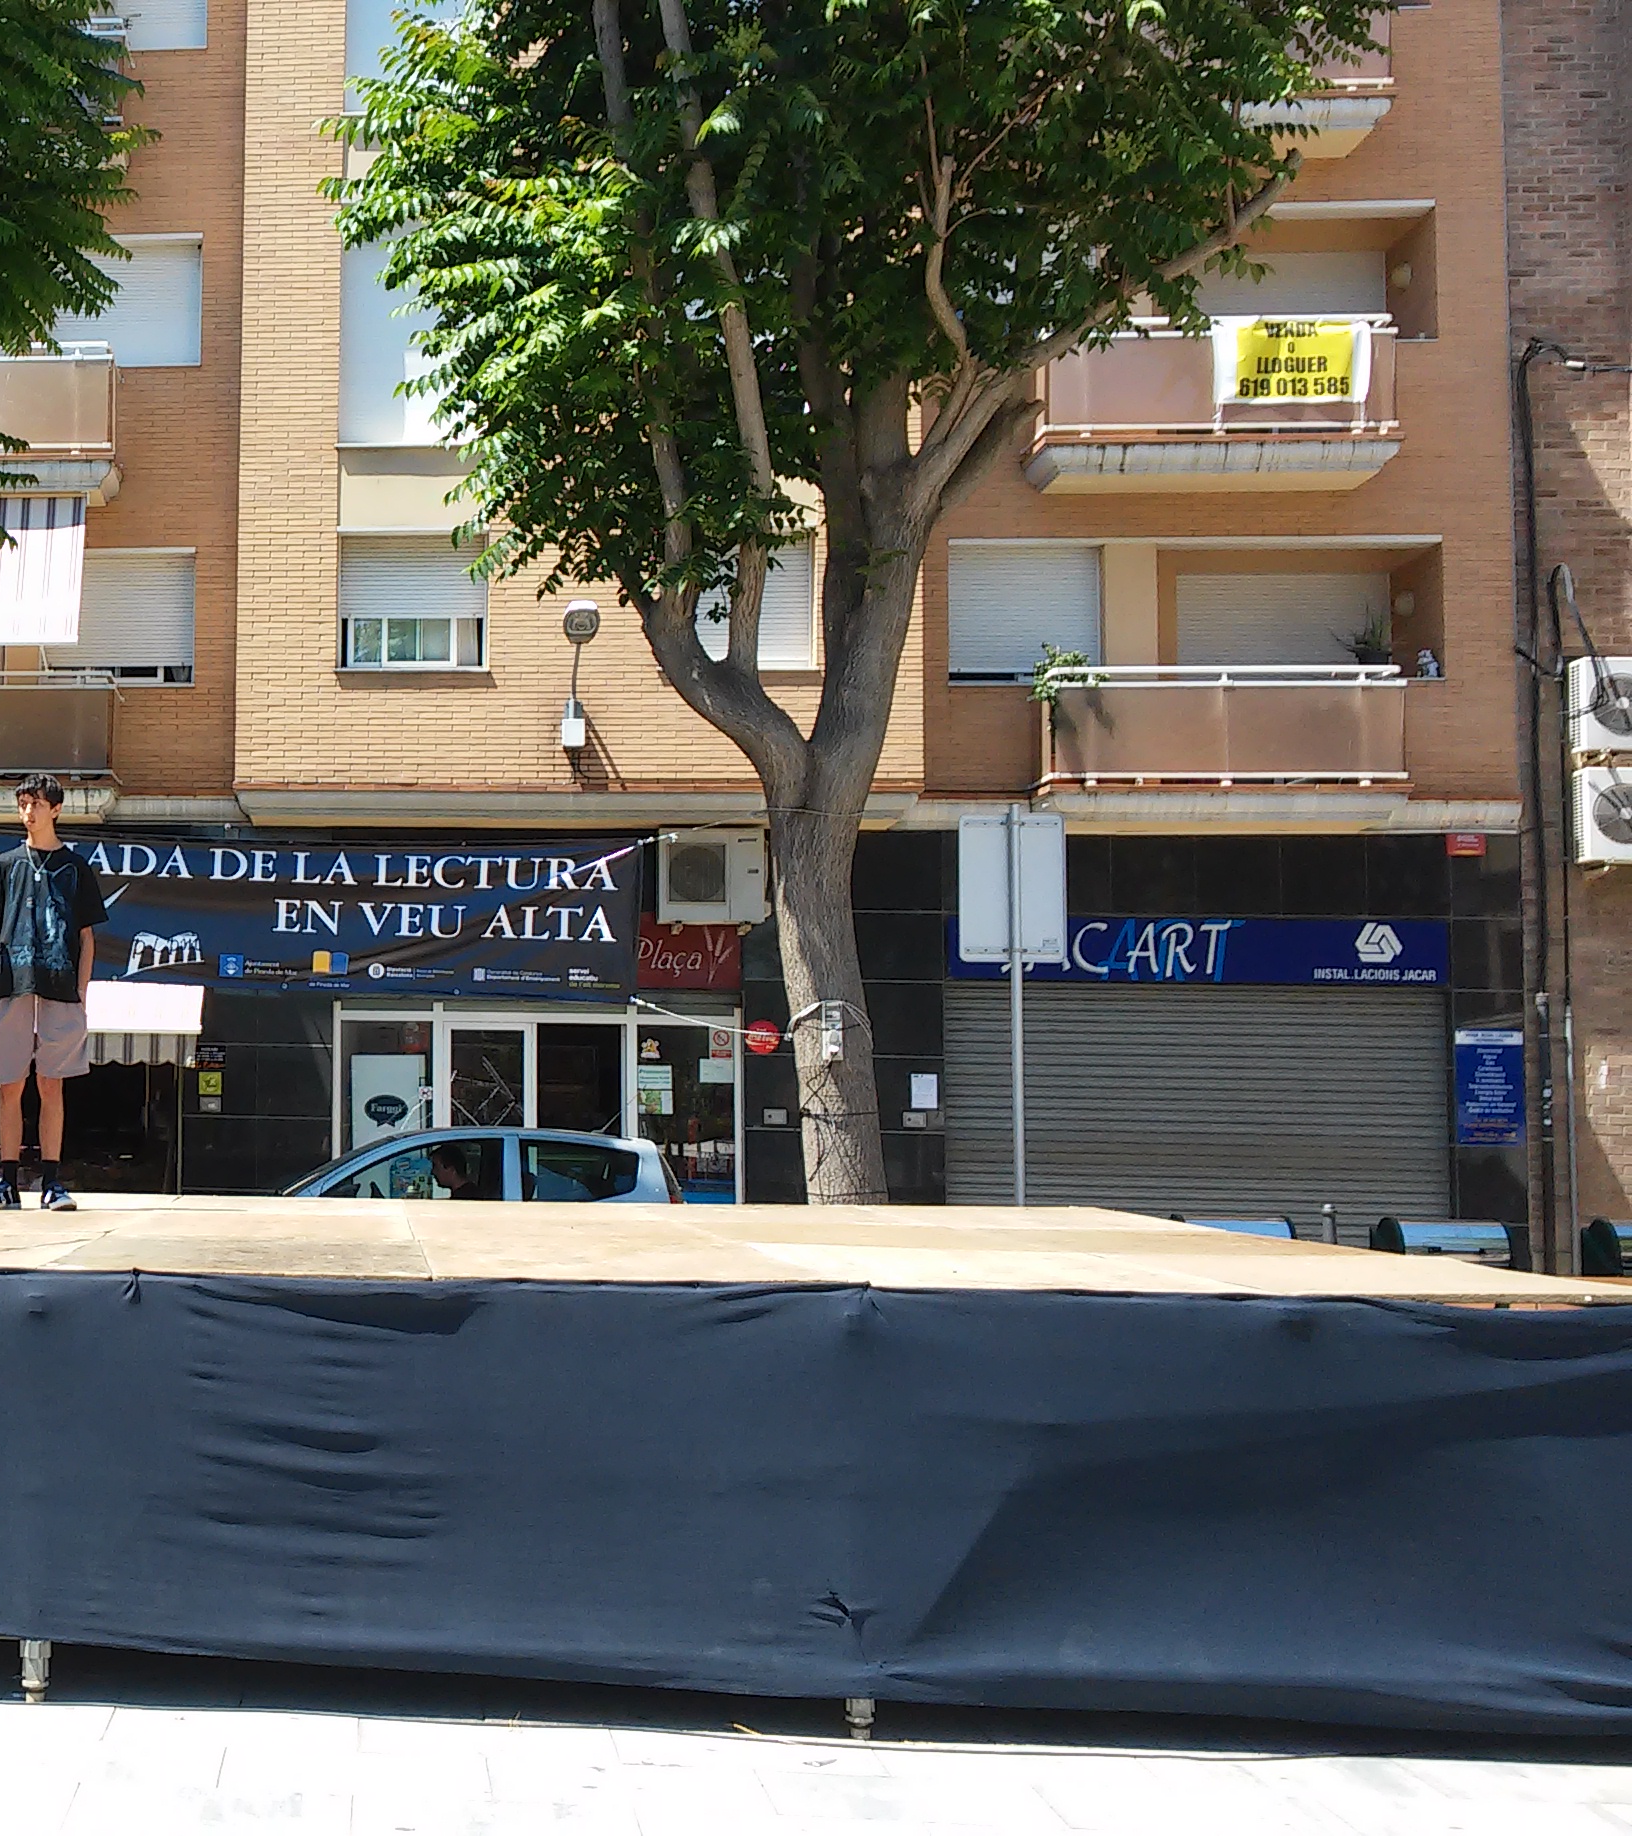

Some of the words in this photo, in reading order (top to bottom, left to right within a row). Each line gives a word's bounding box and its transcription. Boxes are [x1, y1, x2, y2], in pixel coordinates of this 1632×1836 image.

[1265, 322, 1318, 338] VENDA
[1256, 356, 1329, 374] LLOGUER
[1239, 377, 1271, 397] 619
[1276, 377, 1309, 397] 013
[1313, 376, 1350, 395] 585
[64, 841, 194, 881] ADA
[209, 848, 279, 883] DE
[291, 850, 358, 886] LA
[372, 853, 620, 892] LECTURA
[272, 898, 344, 936] EN
[357, 902, 468, 940] VEU
[480, 903, 618, 943] ALTA
[638, 936, 703, 977] Plaça
[1402, 969, 1437, 981] JACAR
